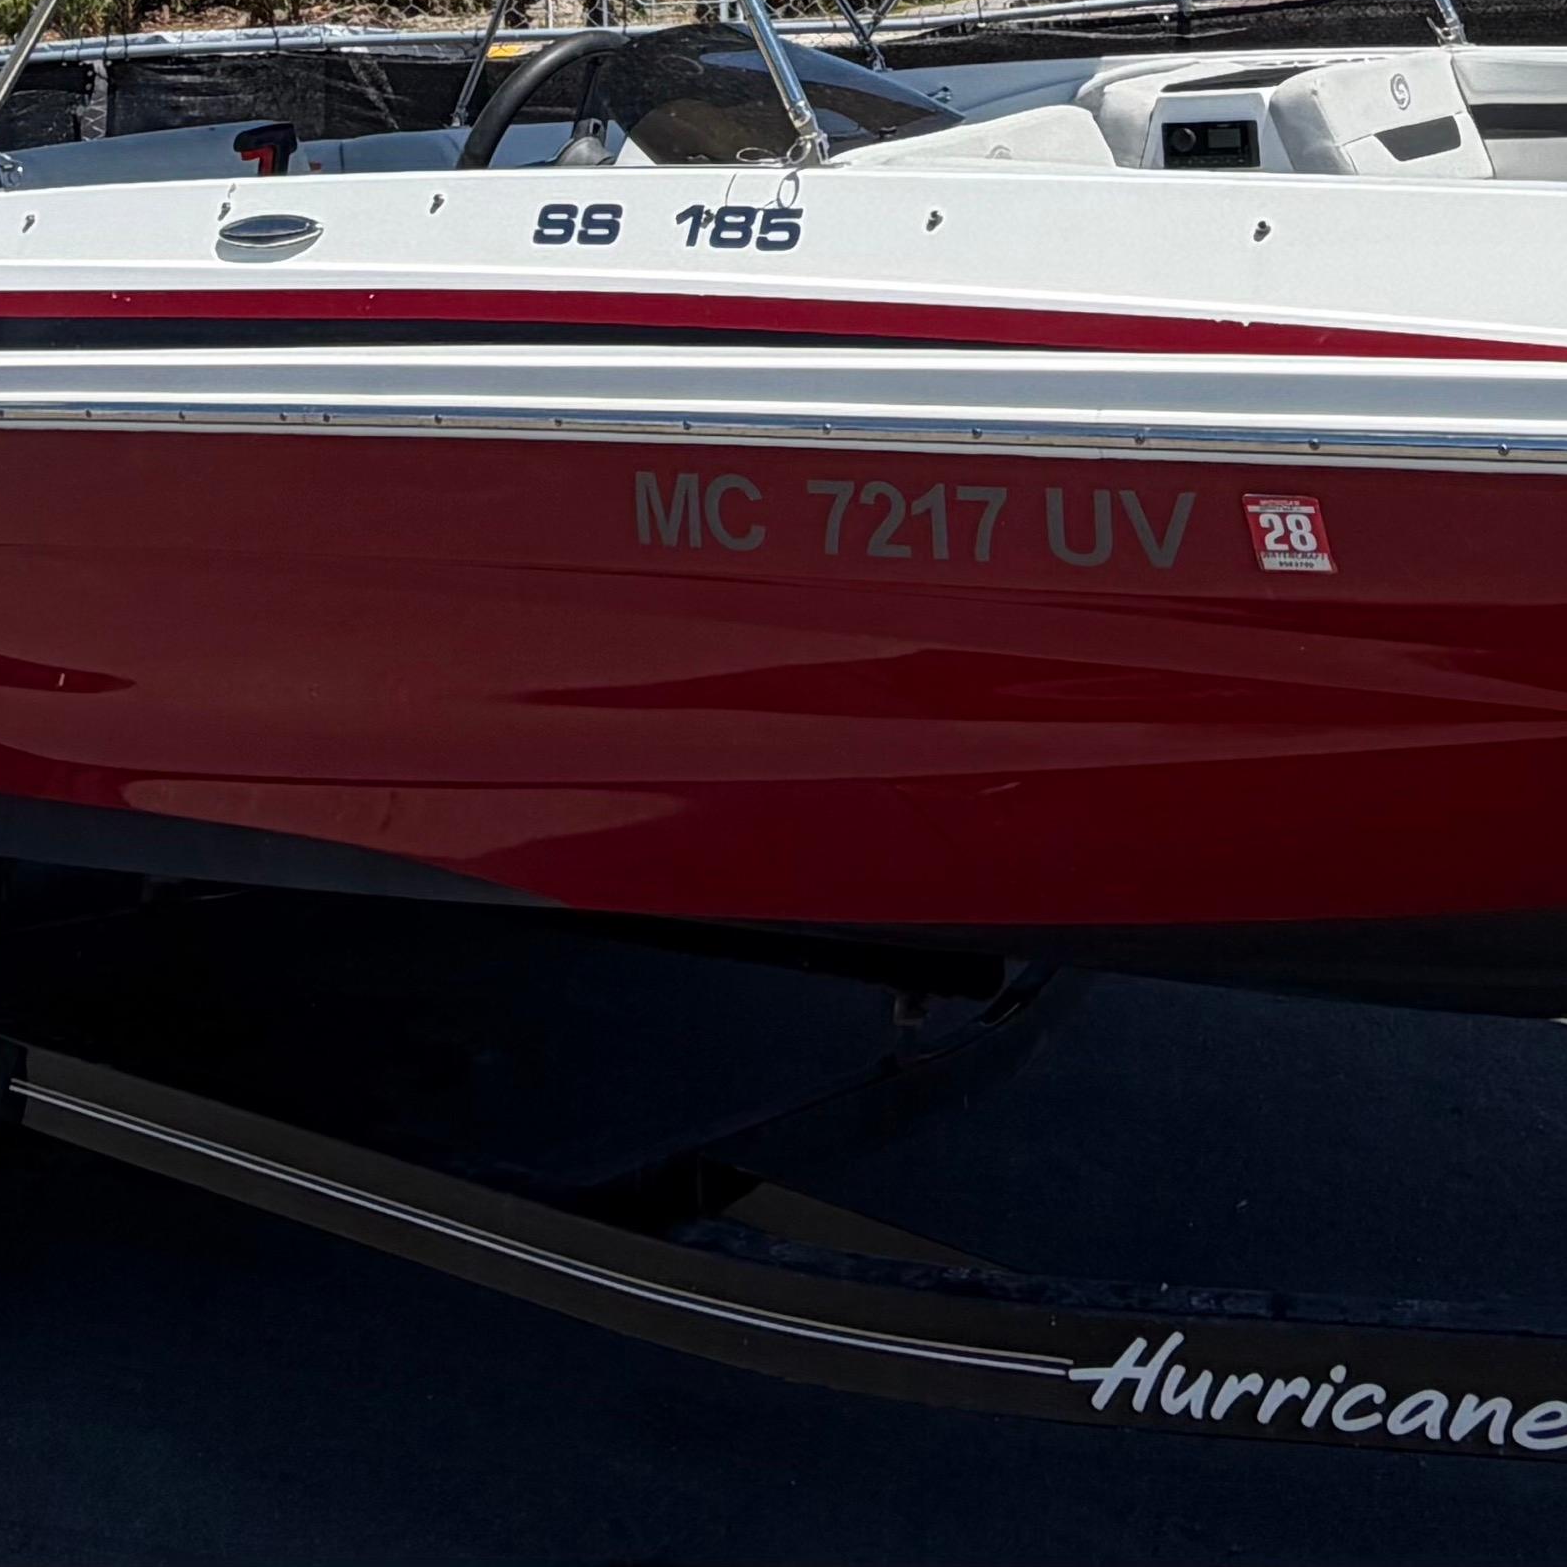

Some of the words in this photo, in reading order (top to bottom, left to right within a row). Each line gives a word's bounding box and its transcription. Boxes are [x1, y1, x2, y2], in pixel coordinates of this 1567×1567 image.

[533, 203, 623, 245] SS
[674, 204, 804, 252] 185
[634, 471, 767, 551] MC
[807, 479, 1008, 562] 7217
[1045, 486, 1196, 569] UV
[1259, 513, 1317, 551] 28
